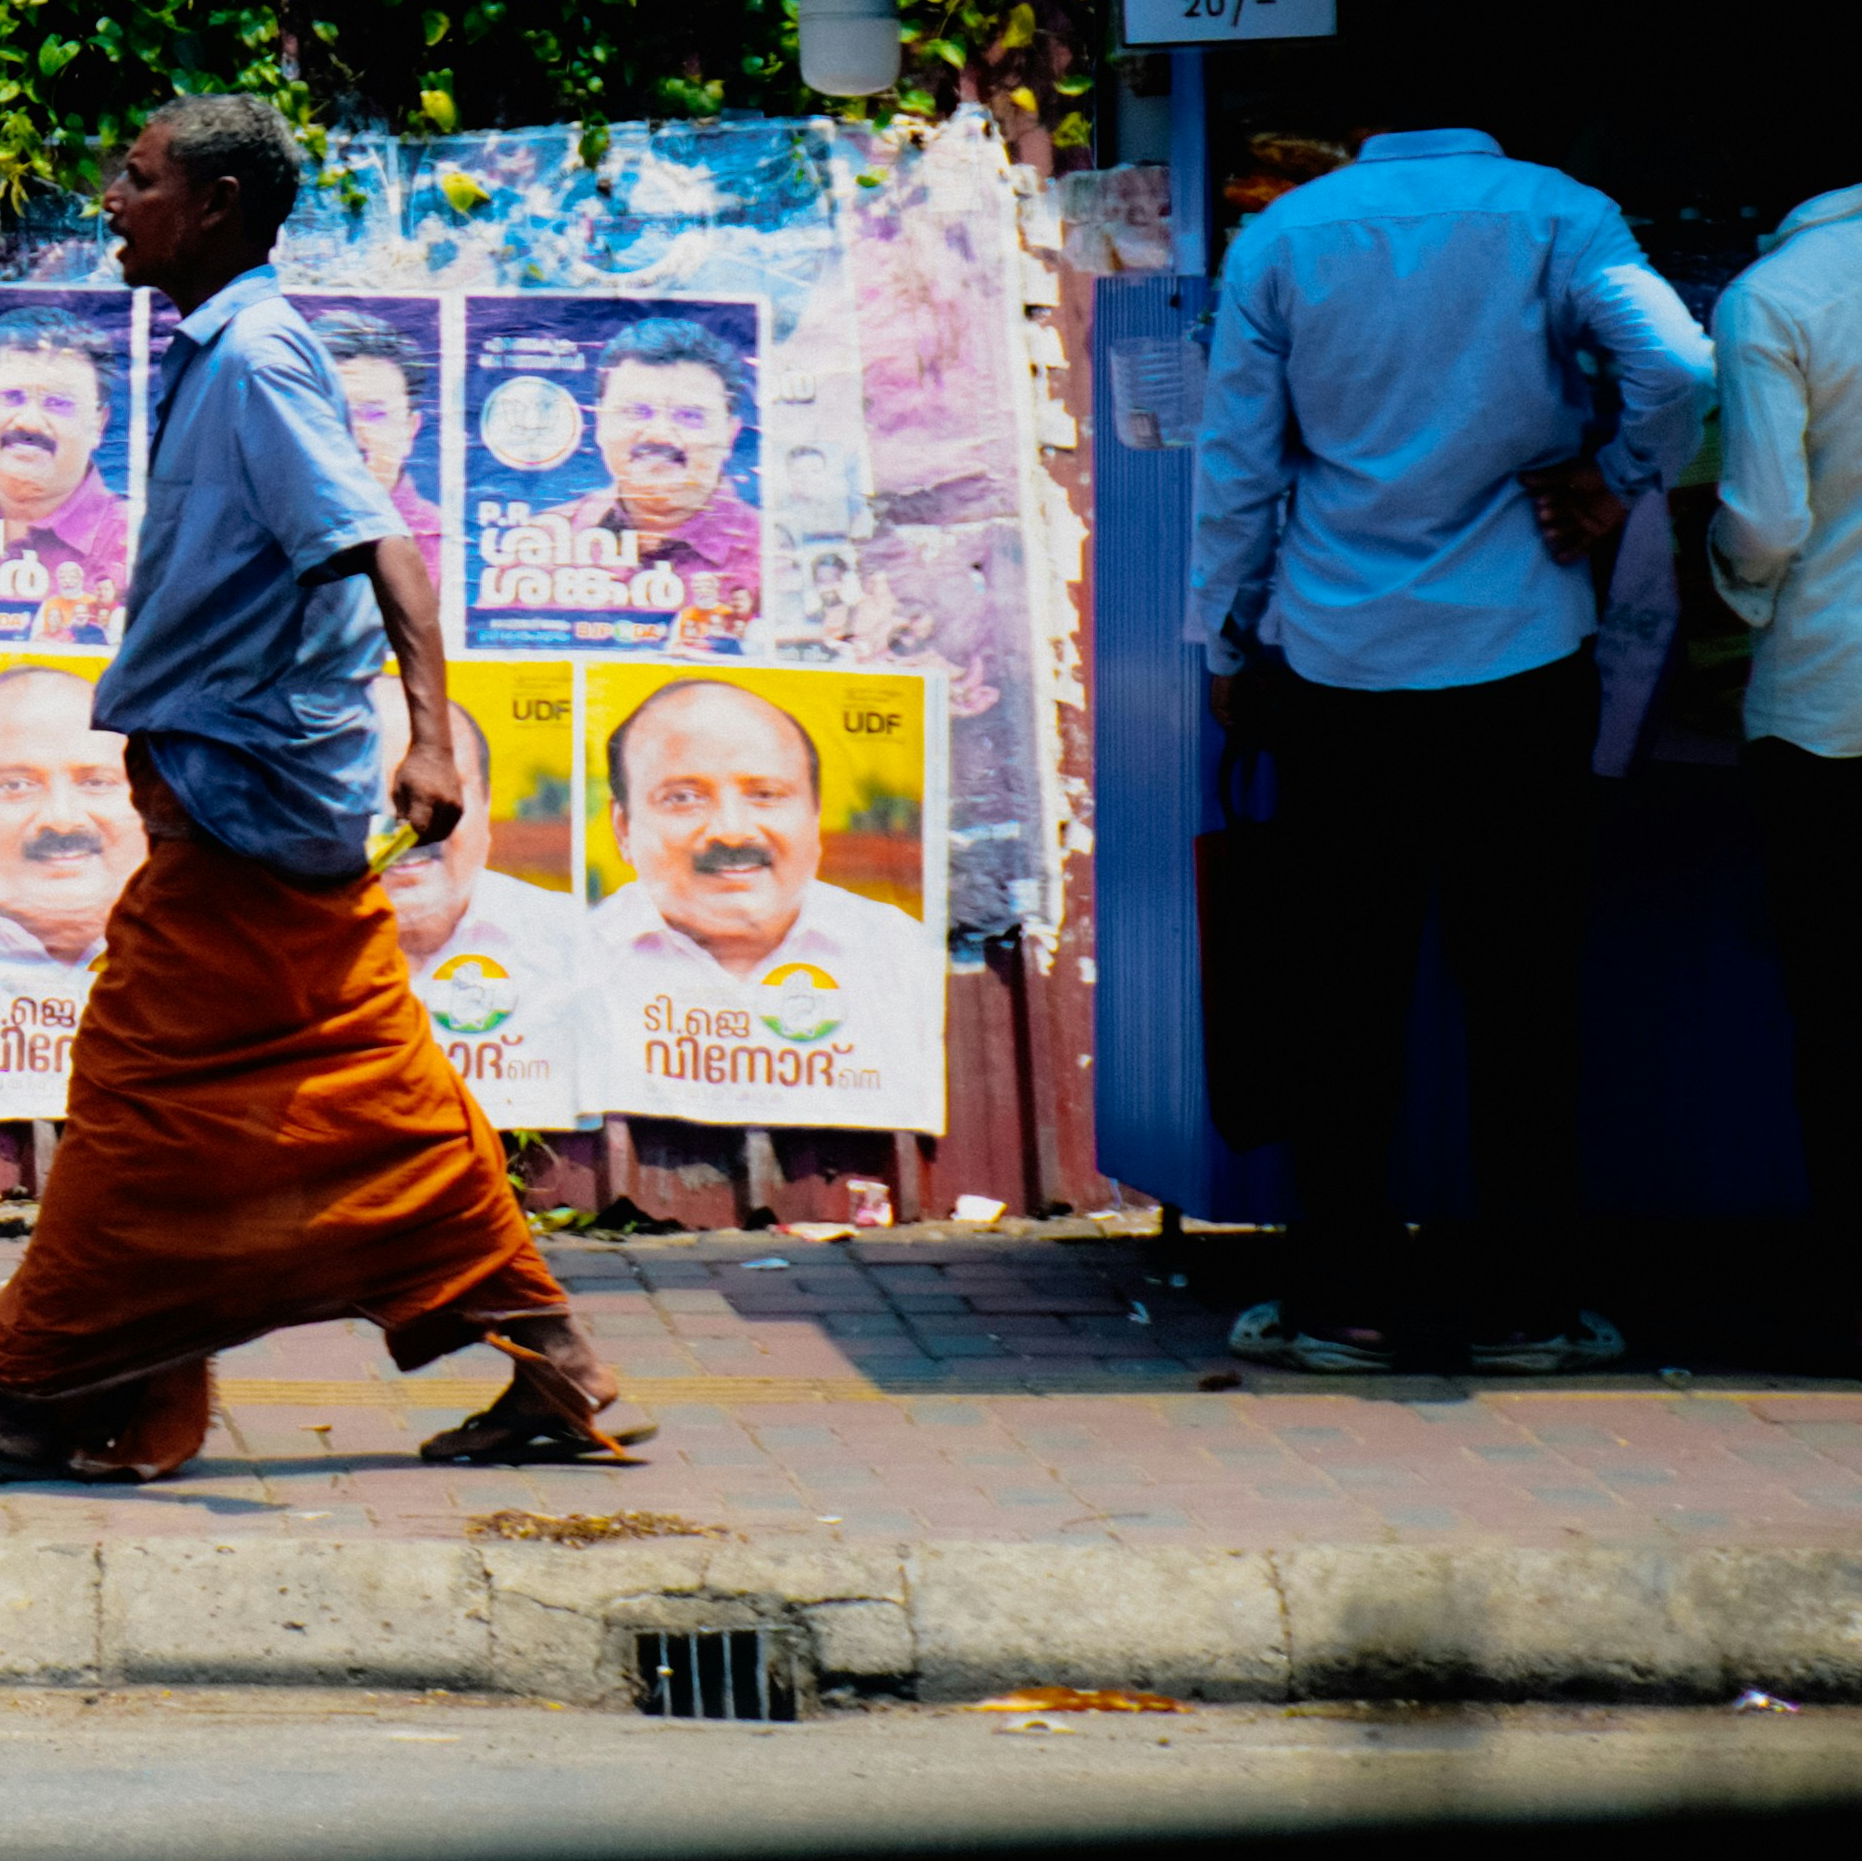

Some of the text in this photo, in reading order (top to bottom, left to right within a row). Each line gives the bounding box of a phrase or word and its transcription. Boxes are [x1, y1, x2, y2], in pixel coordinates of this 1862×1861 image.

[479, 513, 638, 567] ശിവ
[479, 560, 684, 608] ശങ്കർ
[513, 699, 571, 722] UDF
[843, 711, 902, 735] UDF
[644, 994, 750, 1038] ടി.ജെ
